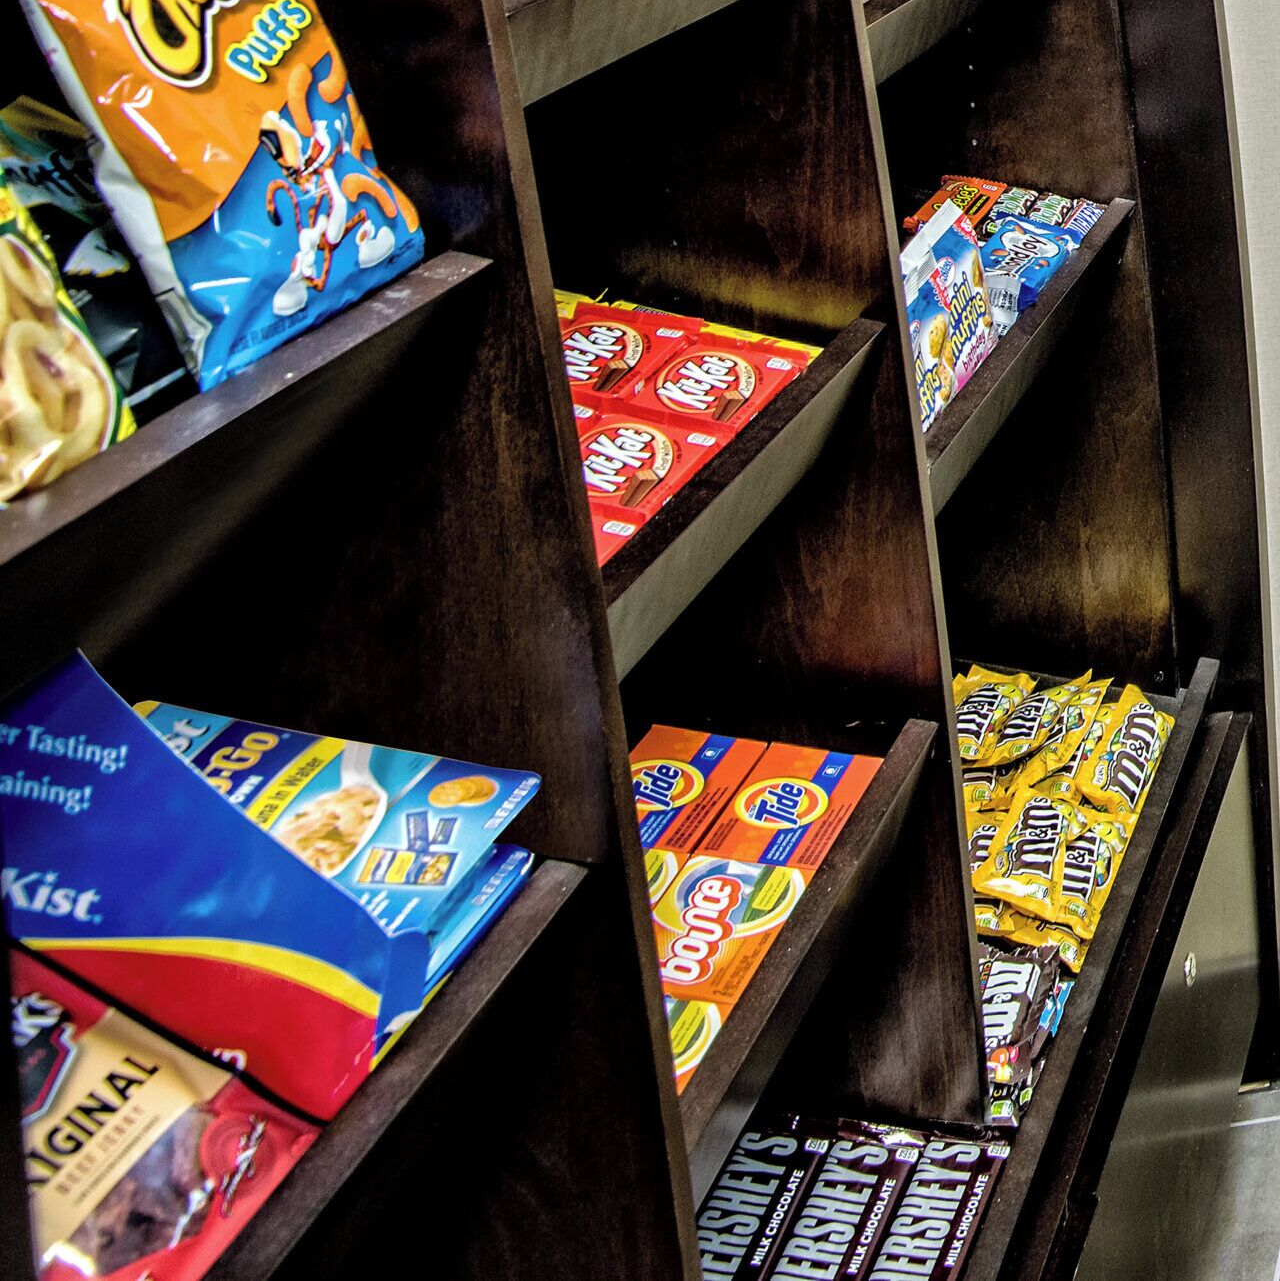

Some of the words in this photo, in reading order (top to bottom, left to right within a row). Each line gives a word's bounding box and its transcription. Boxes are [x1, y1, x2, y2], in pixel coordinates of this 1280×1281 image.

[0, 769, 94, 816] aining!
[1, 722, 22, 746] er
[27, 725, 129, 775] Tasting!
[632, 763, 680, 810] Tide
[753, 781, 805, 827] Tide
[661, 878, 735, 982] bounce
[698, 1132, 798, 1281] ERSHEY'S
[750, 1235, 772, 1267] MILK
[767, 1168, 805, 1238] CHOCOLATE
[770, 1140, 889, 1281] ERSHEY'S
[846, 1243, 869, 1276] MILK
[861, 1177, 897, 1246] CHOCOLATE
[869, 1141, 982, 1281] ERSHEY'S
[944, 1236, 967, 1269] MILK
[957, 1173, 990, 1239] CHOCOLATE
